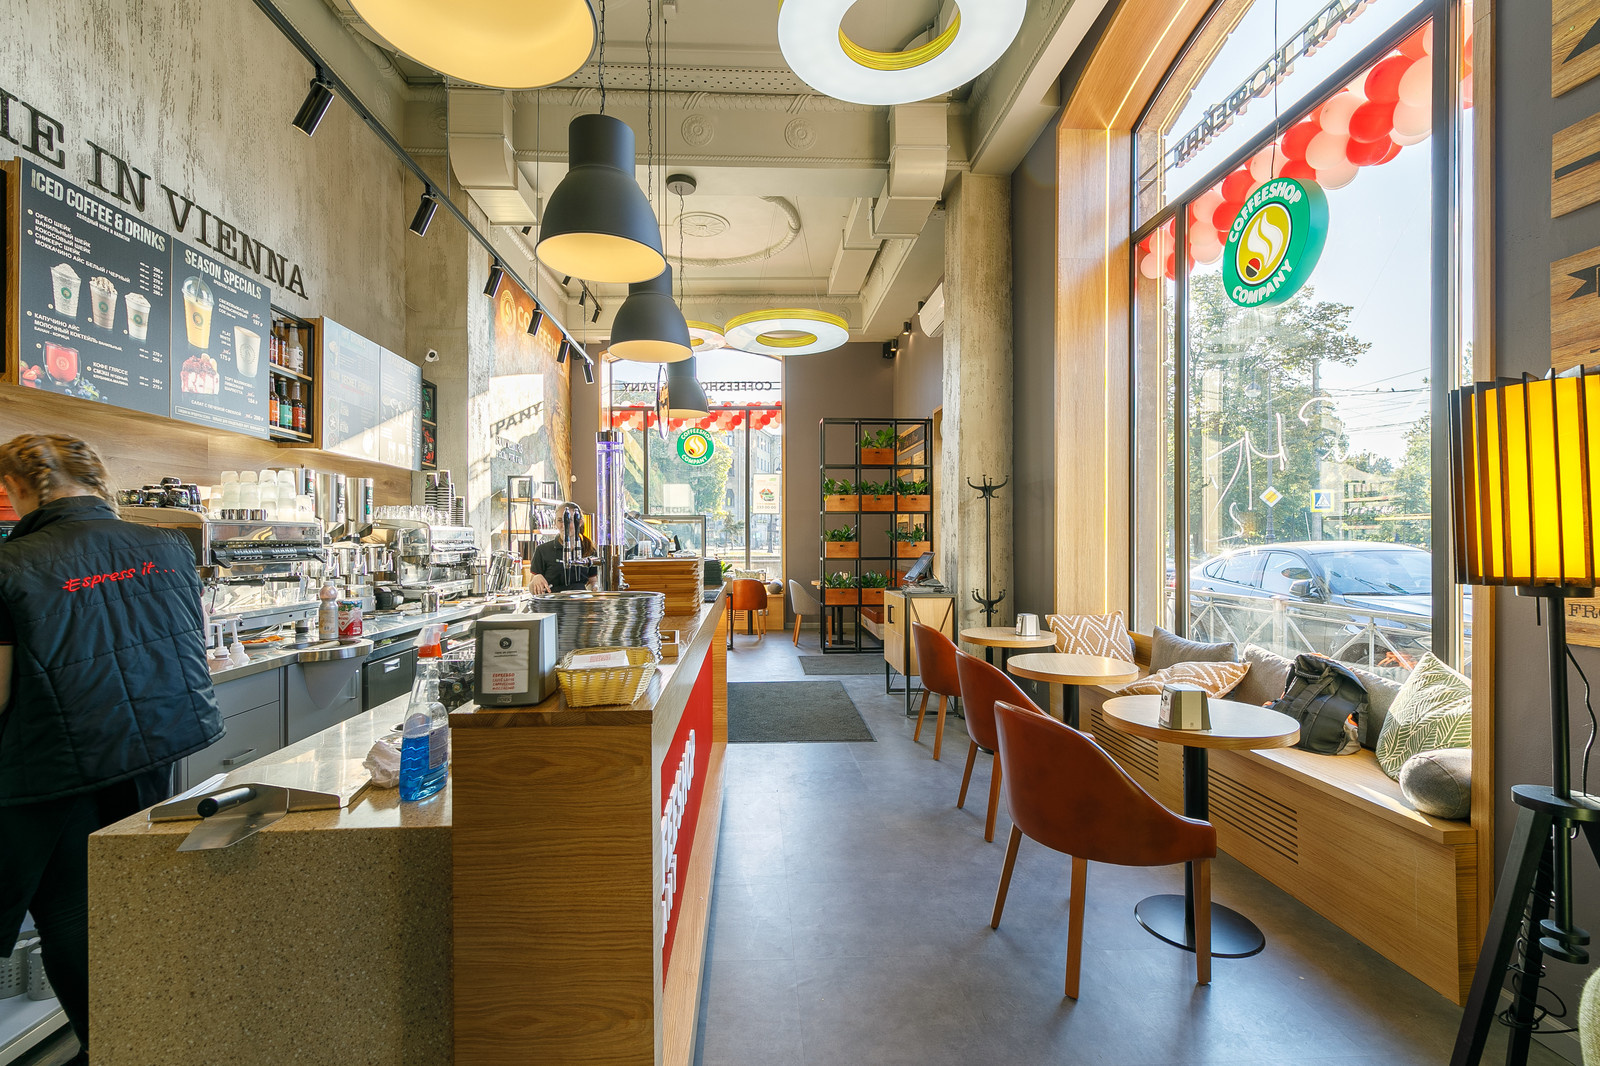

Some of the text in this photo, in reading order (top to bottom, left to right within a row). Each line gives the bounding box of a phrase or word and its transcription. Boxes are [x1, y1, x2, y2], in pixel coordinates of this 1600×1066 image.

[31, 168, 166, 252] ICED COFFEE & DRINKS
[34, 212, 53, 224] ОРЕО
[87, 139, 151, 212] IN
[161, 184, 309, 300] VIENNA
[1229, 182, 1301, 243] COFFEESHOP
[184, 249, 221, 280] SEASON
[223, 269, 262, 300] SPECIALS
[1232, 259, 1292, 304] COMPANY
[34, 312, 68, 328] КАПУЧИНО
[34, 320, 70, 336] МОЛОЧНЫЙ
[681, 428, 712, 441] COFFEESHOP
[681, 455, 707, 464] COMPANY
[62, 567, 136, 593] Espress
